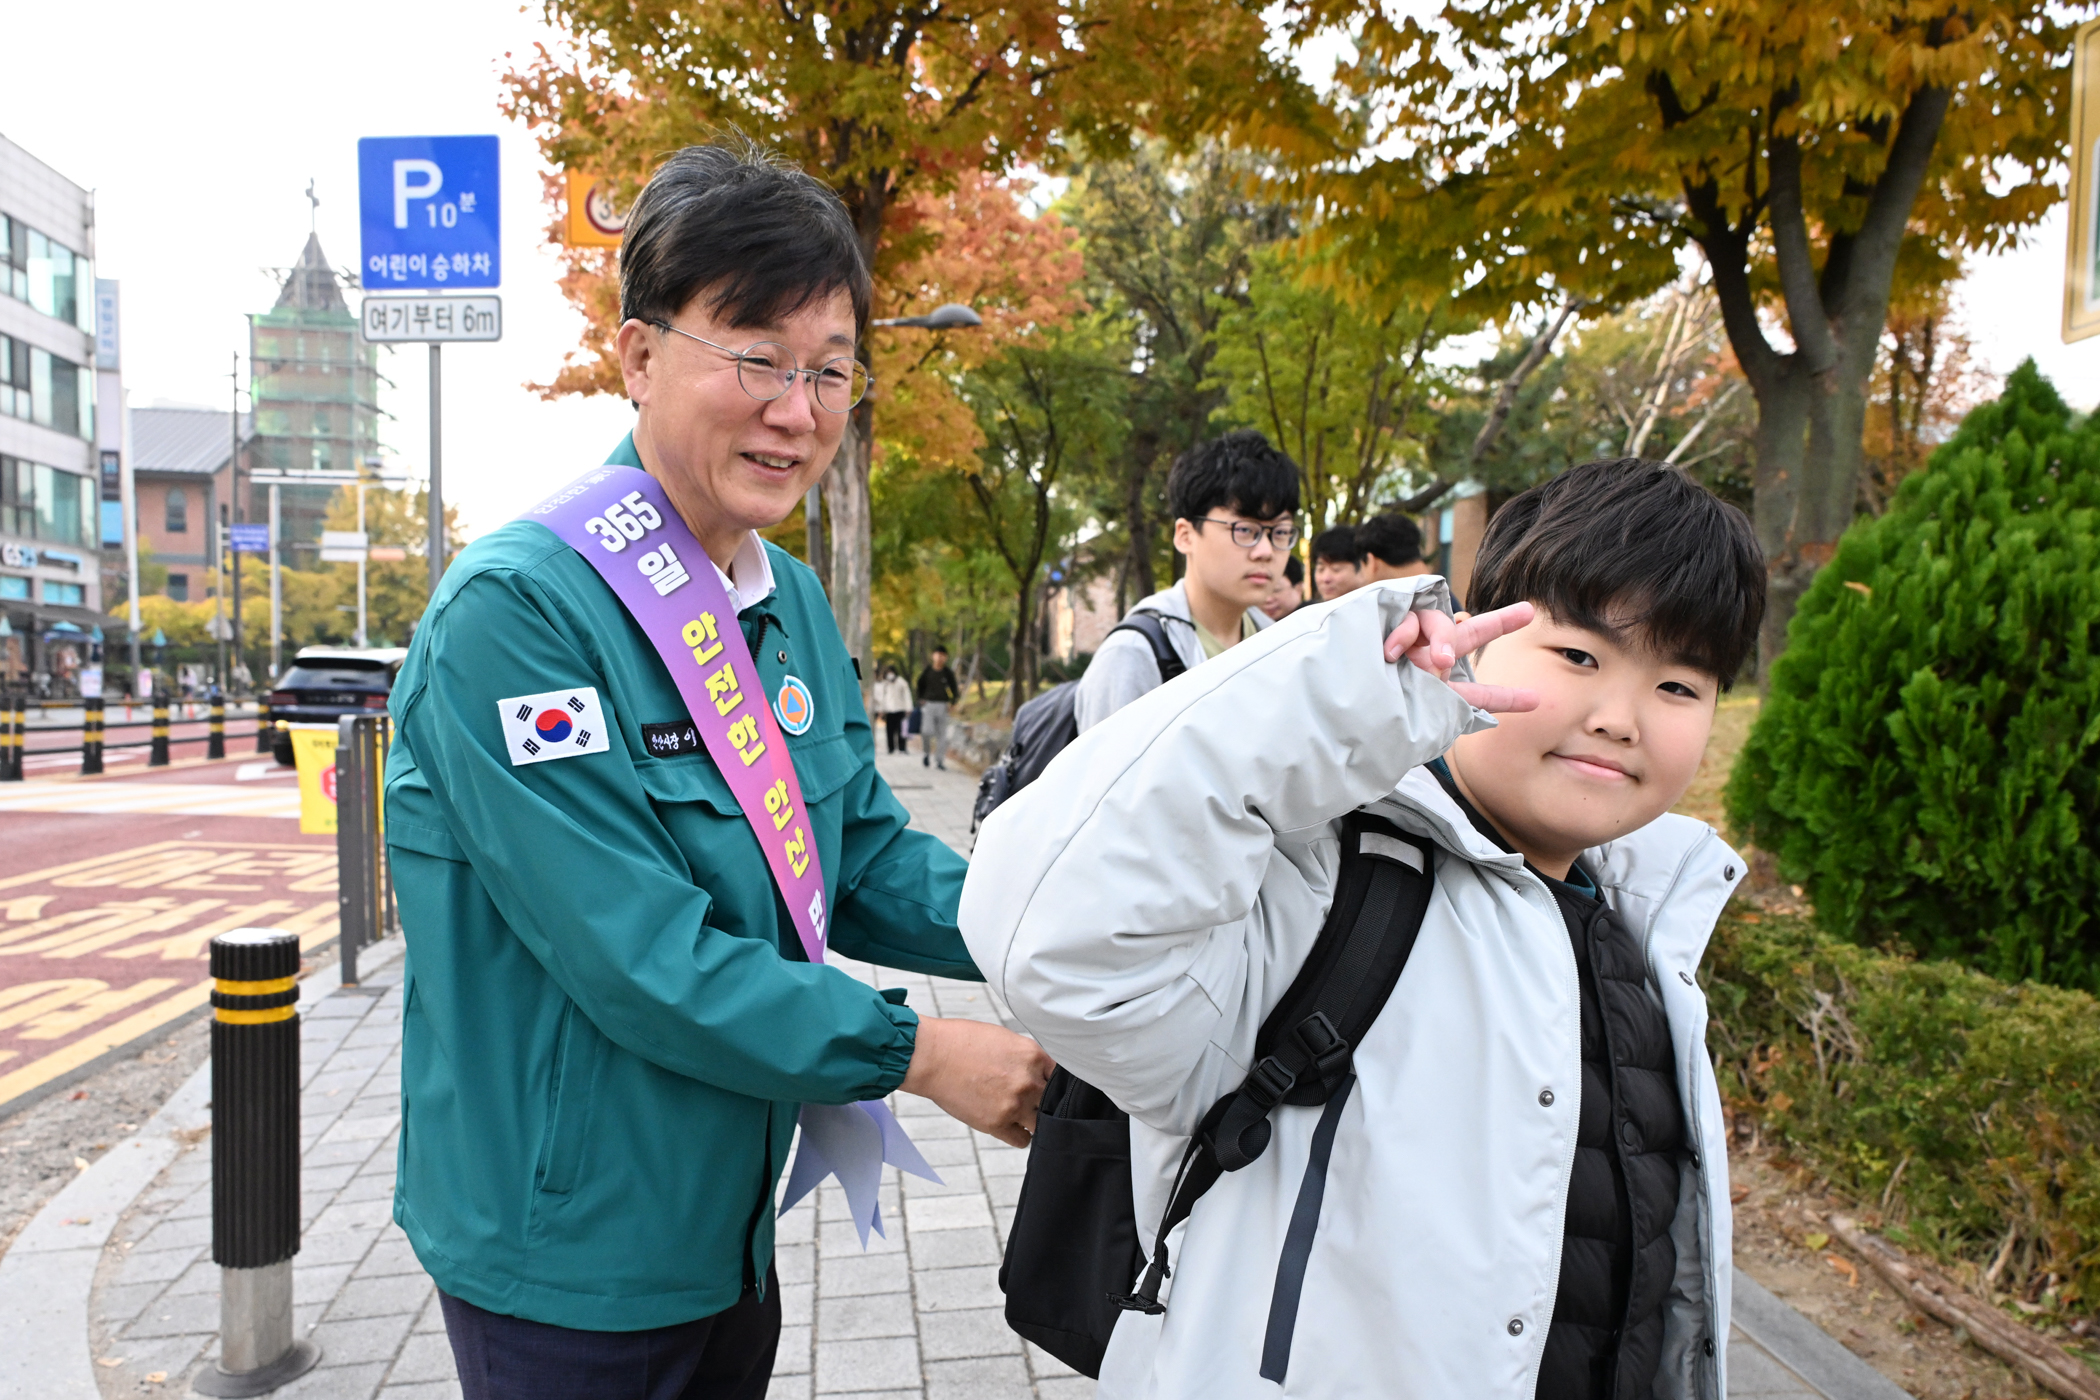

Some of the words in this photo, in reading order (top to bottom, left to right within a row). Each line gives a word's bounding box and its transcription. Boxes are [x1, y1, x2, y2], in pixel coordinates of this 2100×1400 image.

[393, 158, 444, 229] P
[368, 252, 427, 282] 어린이
[430, 252, 492, 282] 승하차
[370, 304, 454, 335] 여기부터
[463, 304, 495, 334] 6m
[682, 611, 766, 767] 안전한
[764, 778, 810, 878] 안산
